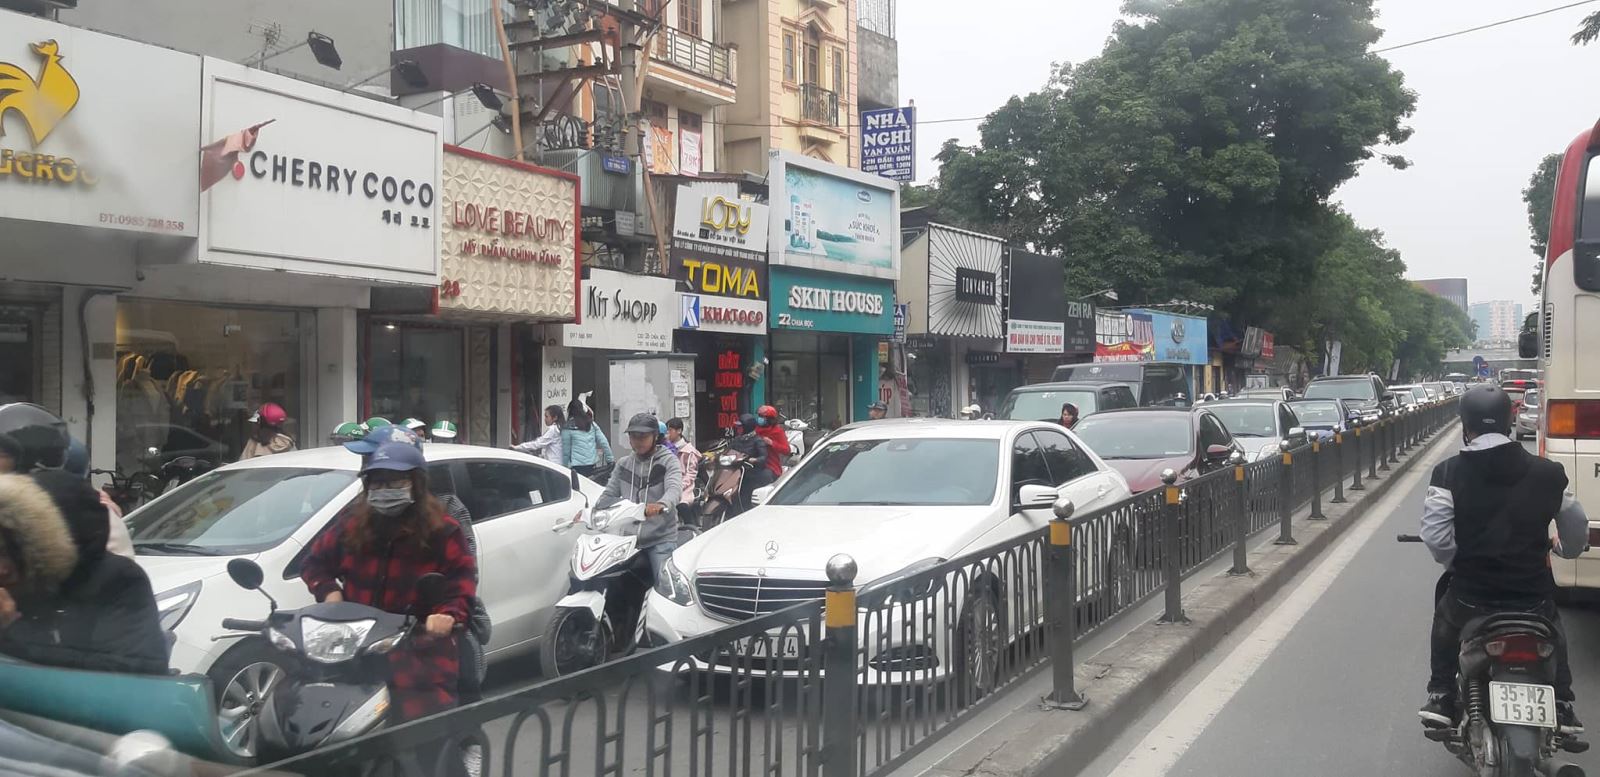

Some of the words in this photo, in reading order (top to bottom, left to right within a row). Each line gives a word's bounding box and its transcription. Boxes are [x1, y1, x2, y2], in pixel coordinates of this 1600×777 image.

[866, 109, 907, 130] NHÀ
[885, 144, 910, 155] XUÂN
[250, 150, 357, 196] CHERRY
[363, 172, 433, 208] COCO
[454, 201, 498, 231] LOVE
[503, 210, 568, 241] BEAUTY
[682, 259, 760, 298] TOMA
[788, 285, 831, 311] SKIN
[832, 290, 884, 315] HOUSE
[703, 306, 764, 325] KHATOCO
[779, 313, 791, 326] 22
[725, 427, 735, 437] 24
[1501, 703, 1546, 722] 1533
